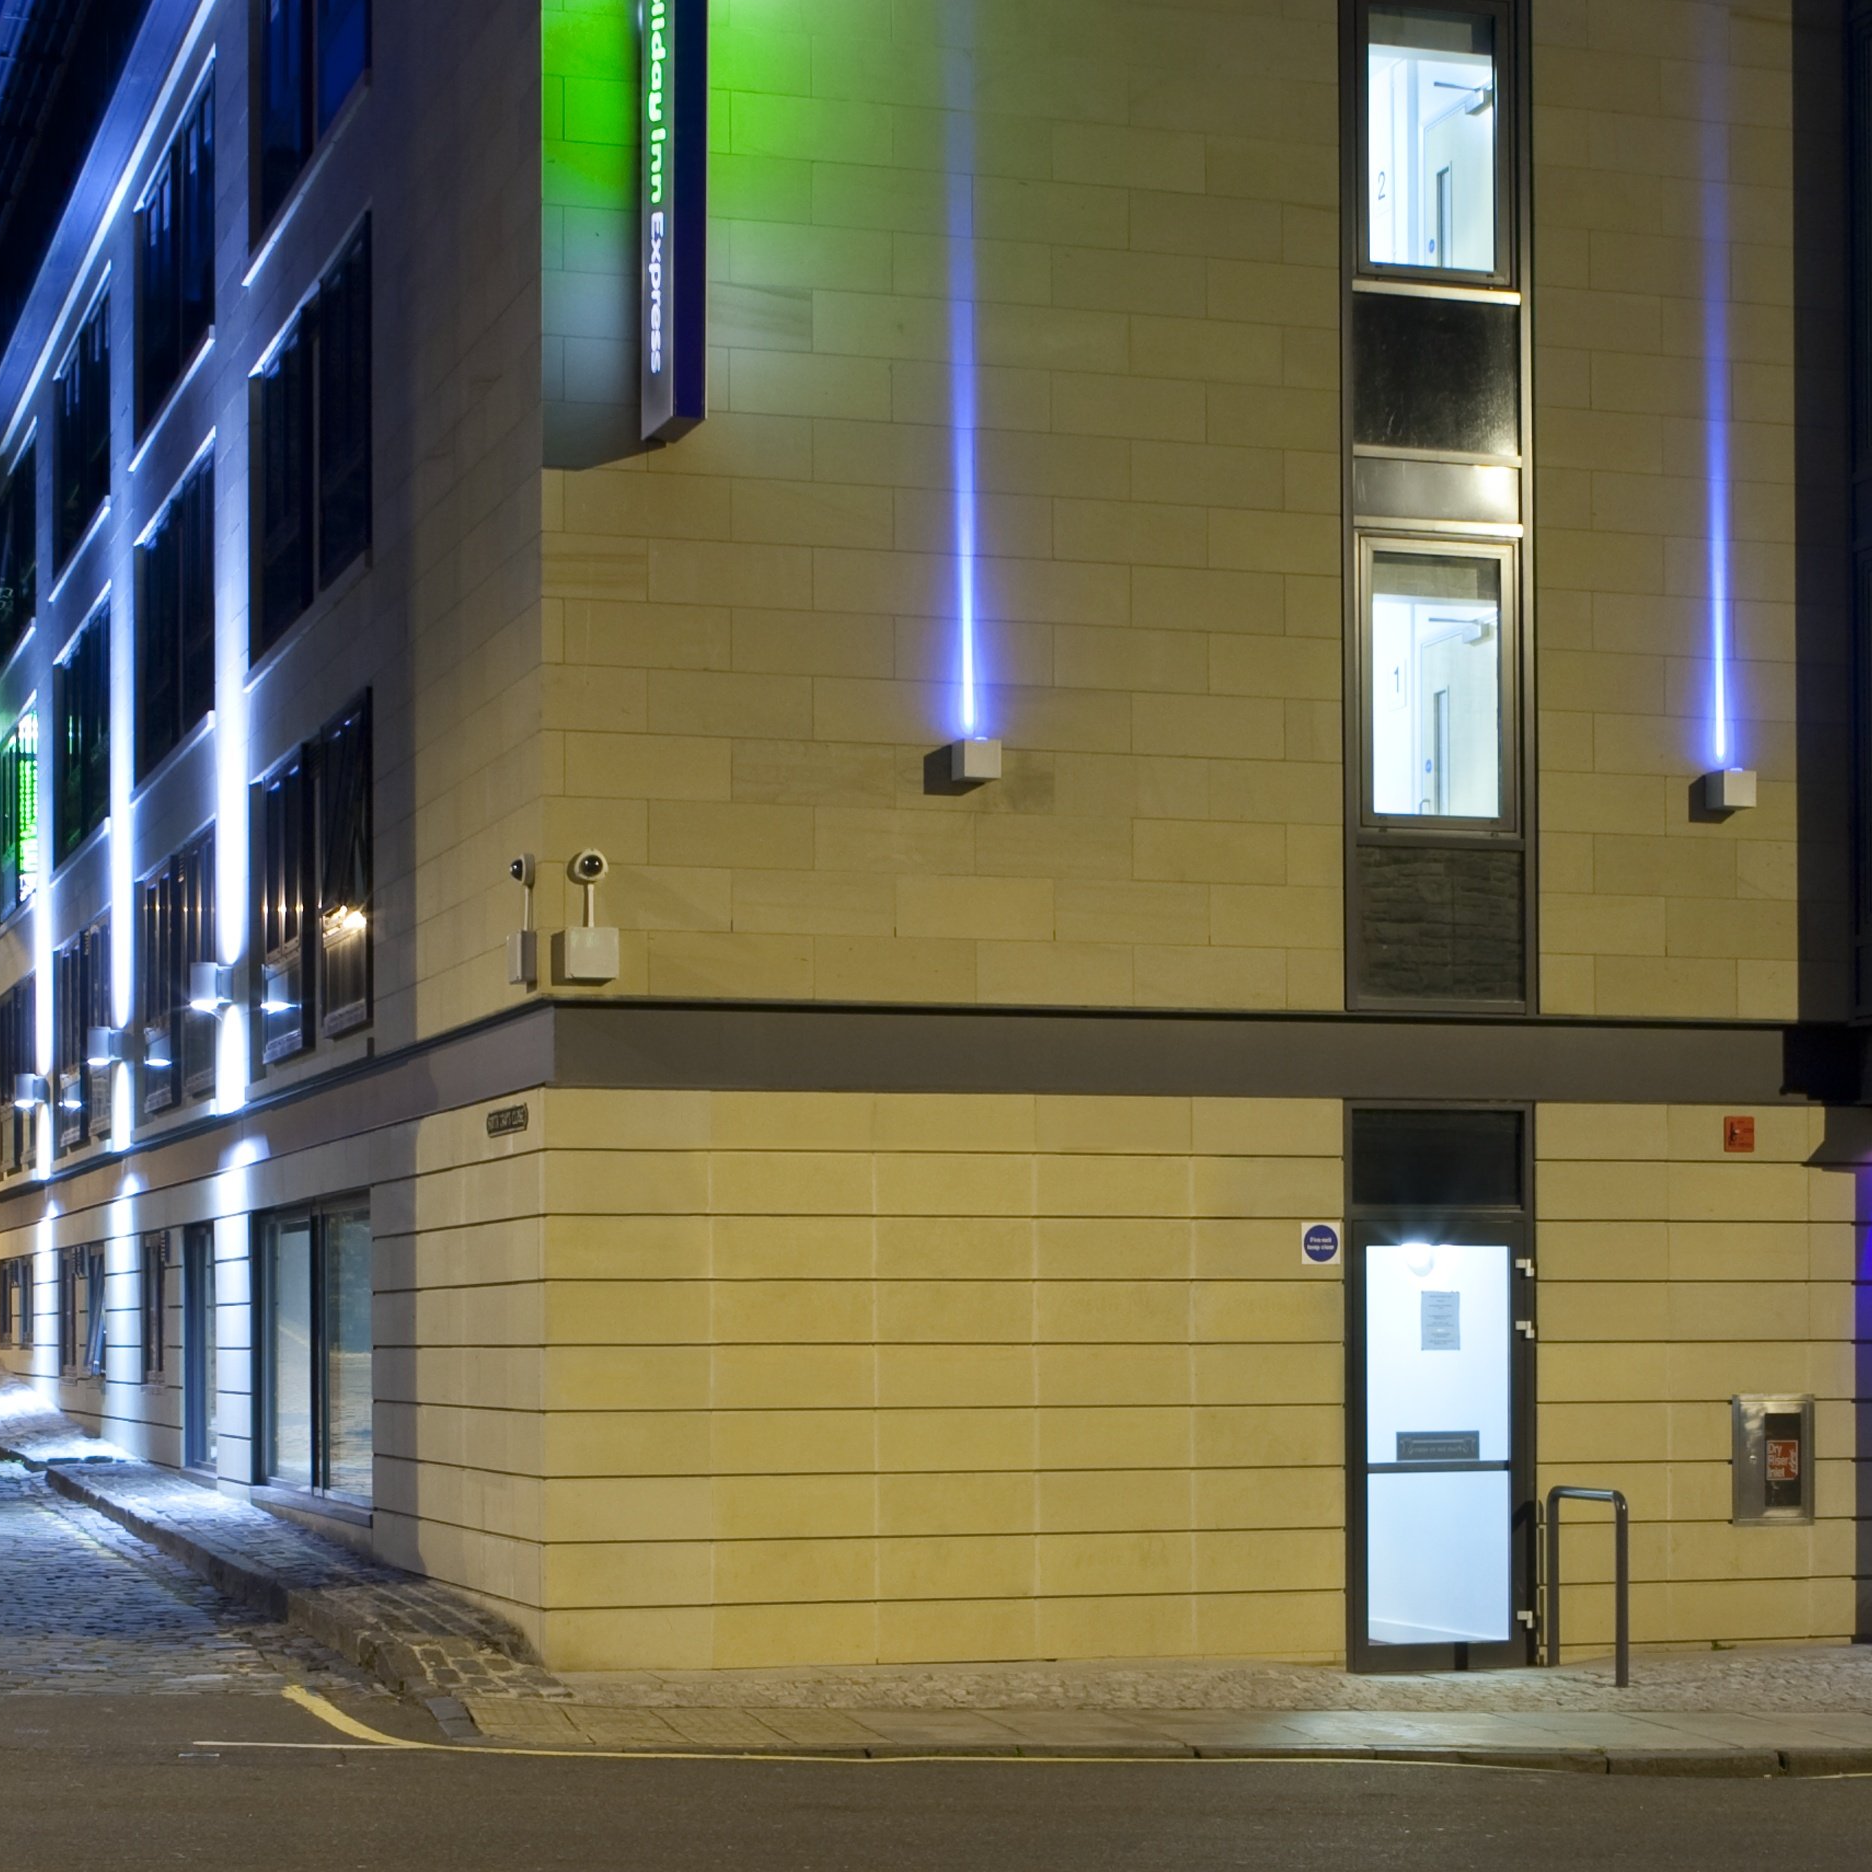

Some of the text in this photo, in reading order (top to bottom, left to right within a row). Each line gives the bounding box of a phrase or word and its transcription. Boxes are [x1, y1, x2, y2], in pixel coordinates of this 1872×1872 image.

[650, 127, 667, 204] Inn
[1378, 171, 1386, 201] 2
[649, 211, 664, 374] Express
